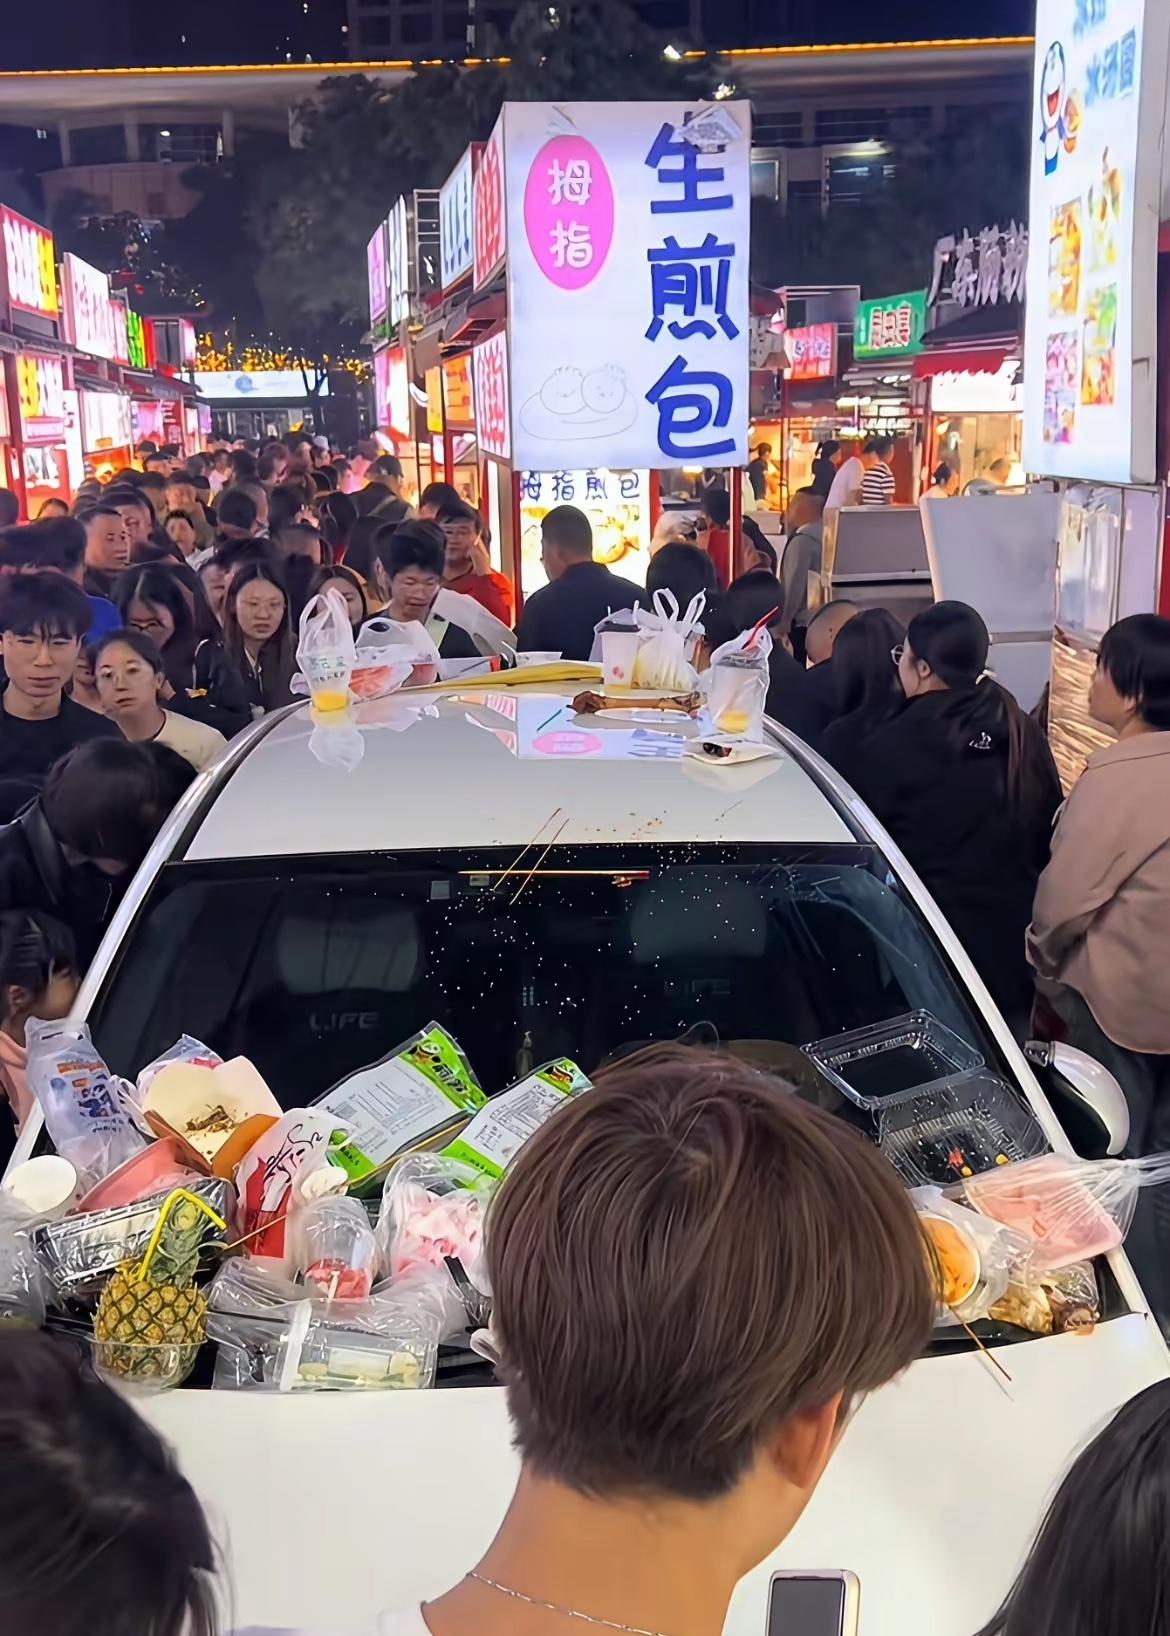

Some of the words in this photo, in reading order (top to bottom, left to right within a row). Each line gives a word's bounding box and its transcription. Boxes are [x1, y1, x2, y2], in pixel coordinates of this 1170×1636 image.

[547, 159, 593, 269] 拇指
[644, 111, 740, 460] 生煎包
[309, 1011, 379, 1032] LIFE
